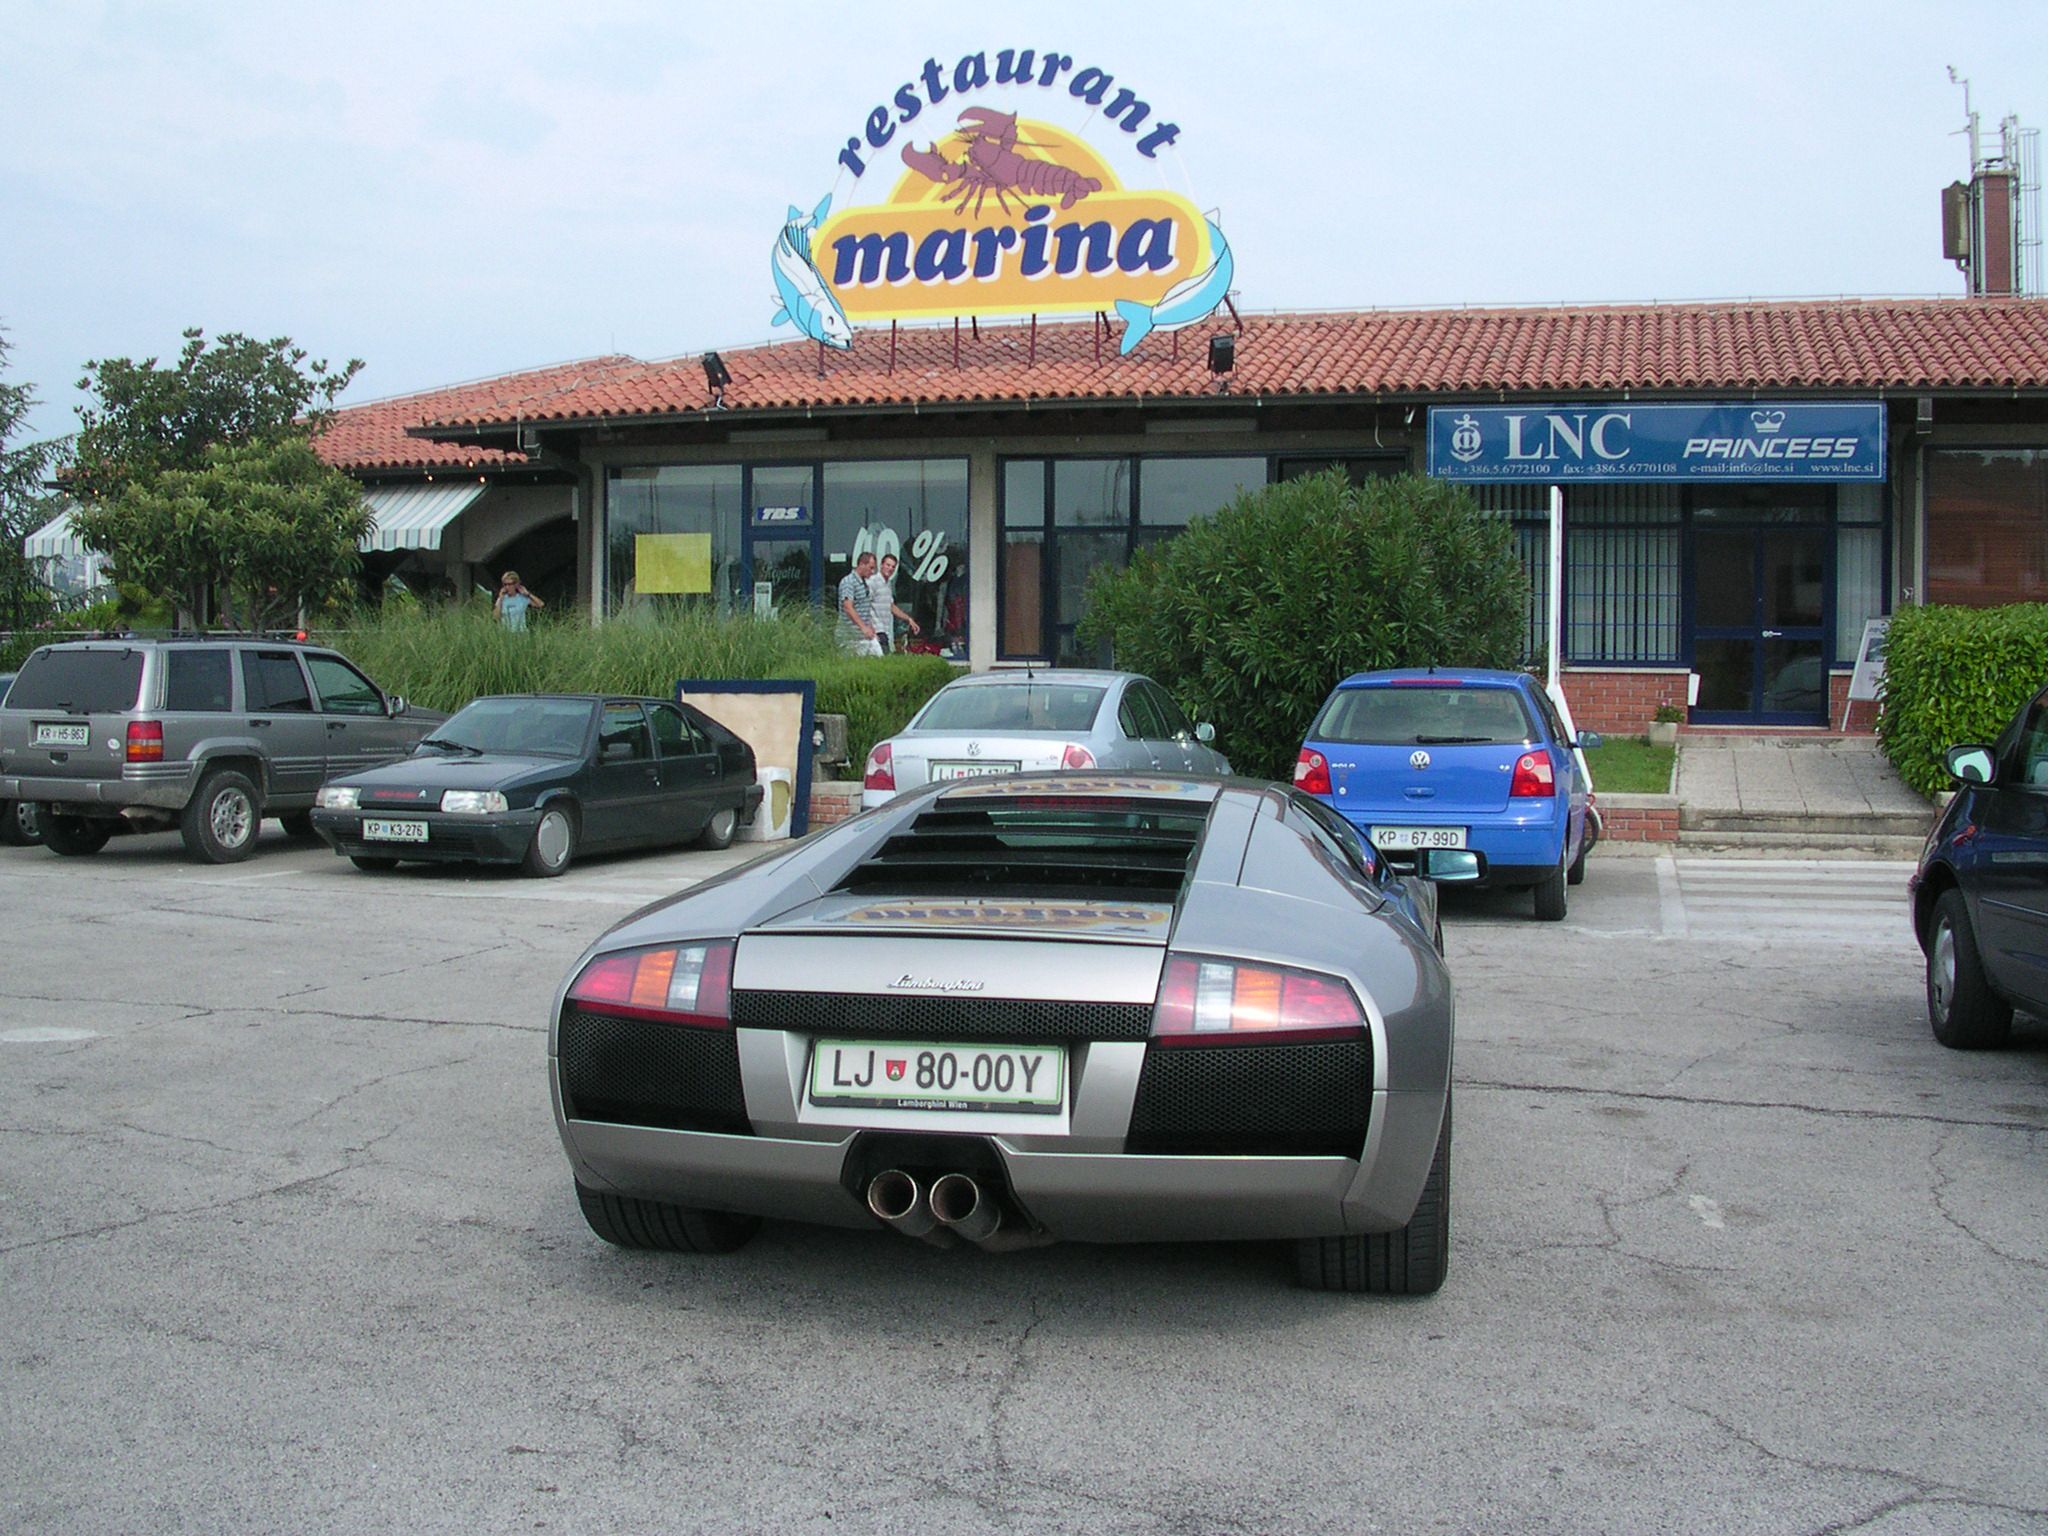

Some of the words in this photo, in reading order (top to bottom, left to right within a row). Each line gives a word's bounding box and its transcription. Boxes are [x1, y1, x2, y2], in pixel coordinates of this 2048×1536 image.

[837, 48, 1181, 179] restaurant
[832, 204, 1176, 287] marina
[1503, 413, 1632, 461] LNC
[1681, 437, 1858, 459] PRINCESS
[1562, 463, 1584, 474] fax:
[1810, 462, 1875, 474] www.lnc.si
[1378, 830, 1397, 845] KP
[1411, 830, 1459, 847] 67-99D
[832, 1049, 876, 1088] LJ
[915, 1051, 1043, 1094] 80-00Y
